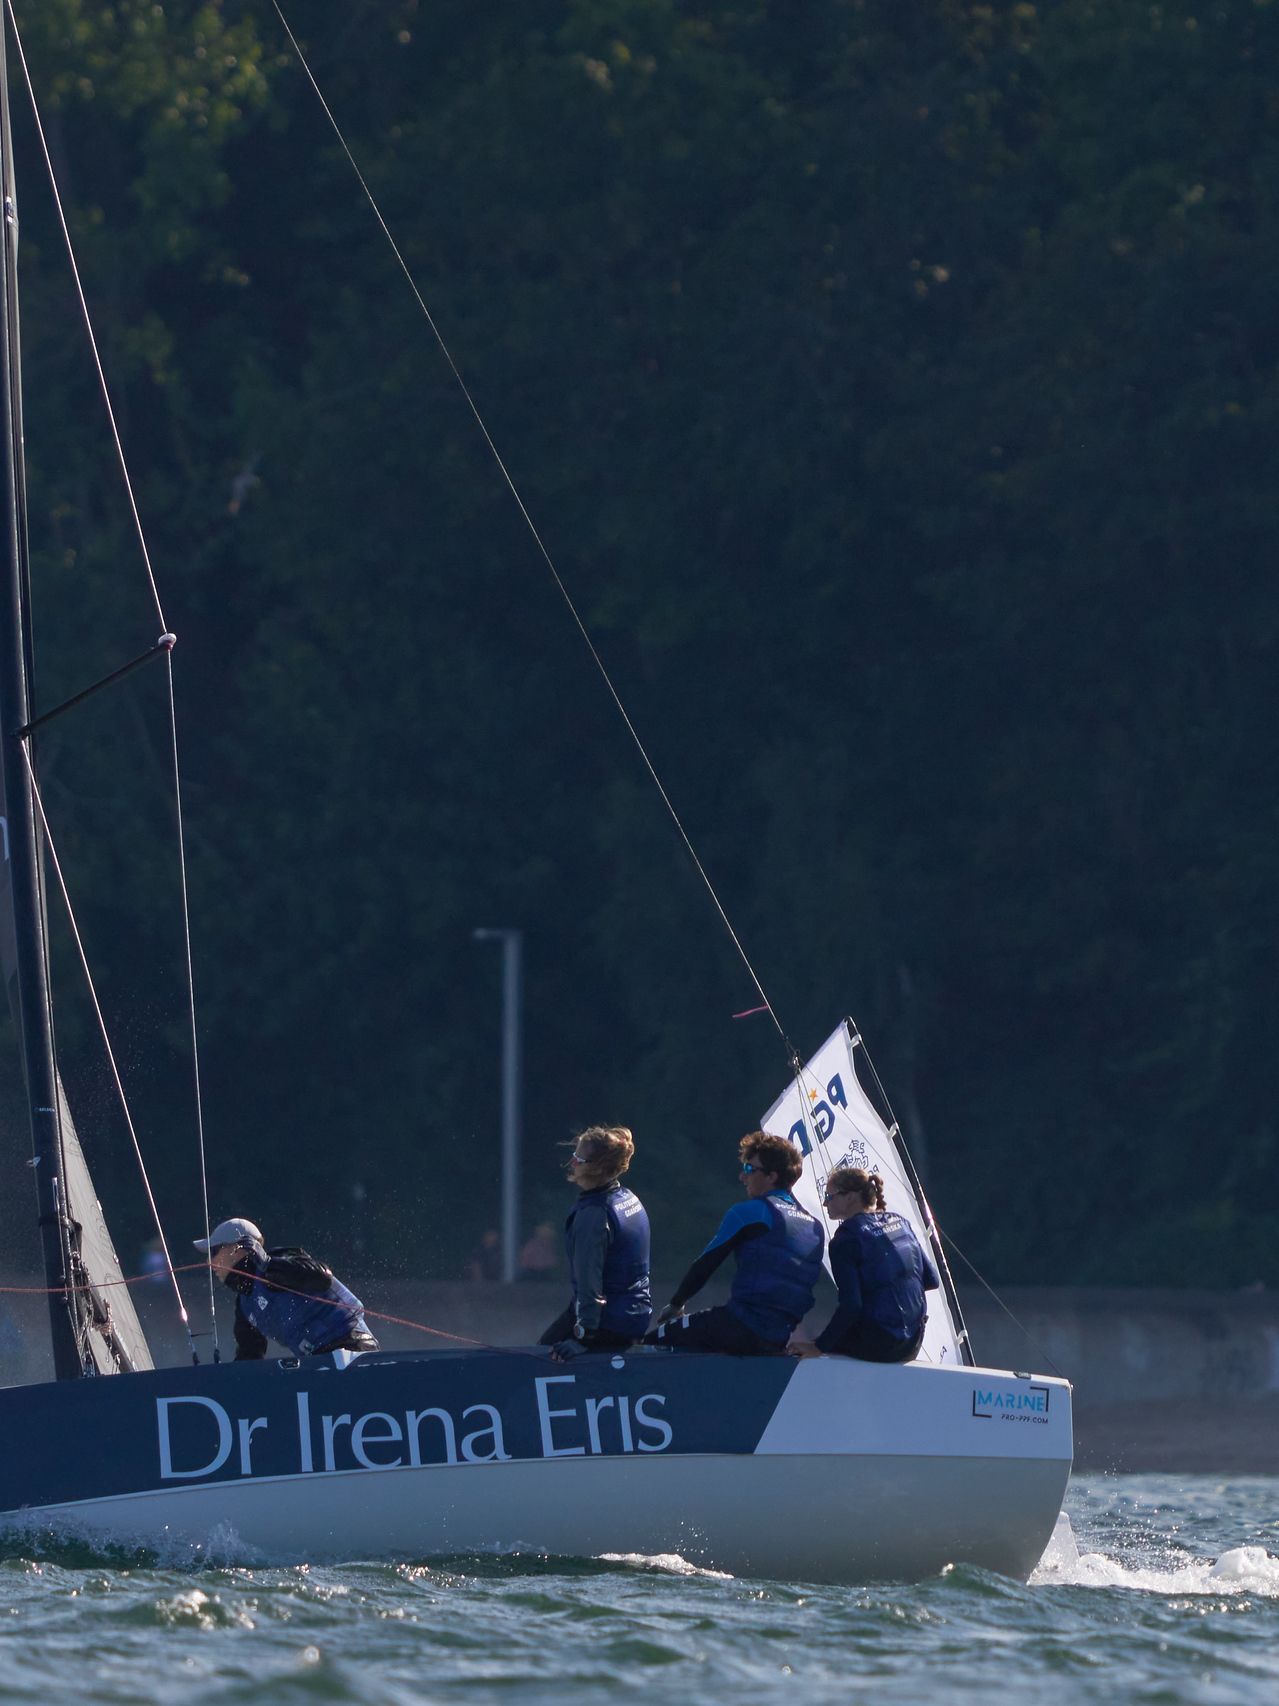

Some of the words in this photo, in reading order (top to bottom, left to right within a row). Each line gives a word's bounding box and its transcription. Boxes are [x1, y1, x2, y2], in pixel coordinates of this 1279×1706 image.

[156, 1396, 268, 1480] Dr
[297, 1391, 512, 1473] Irena
[535, 1375, 674, 1458] Eris
[977, 1390, 1044, 1412] MARINE
